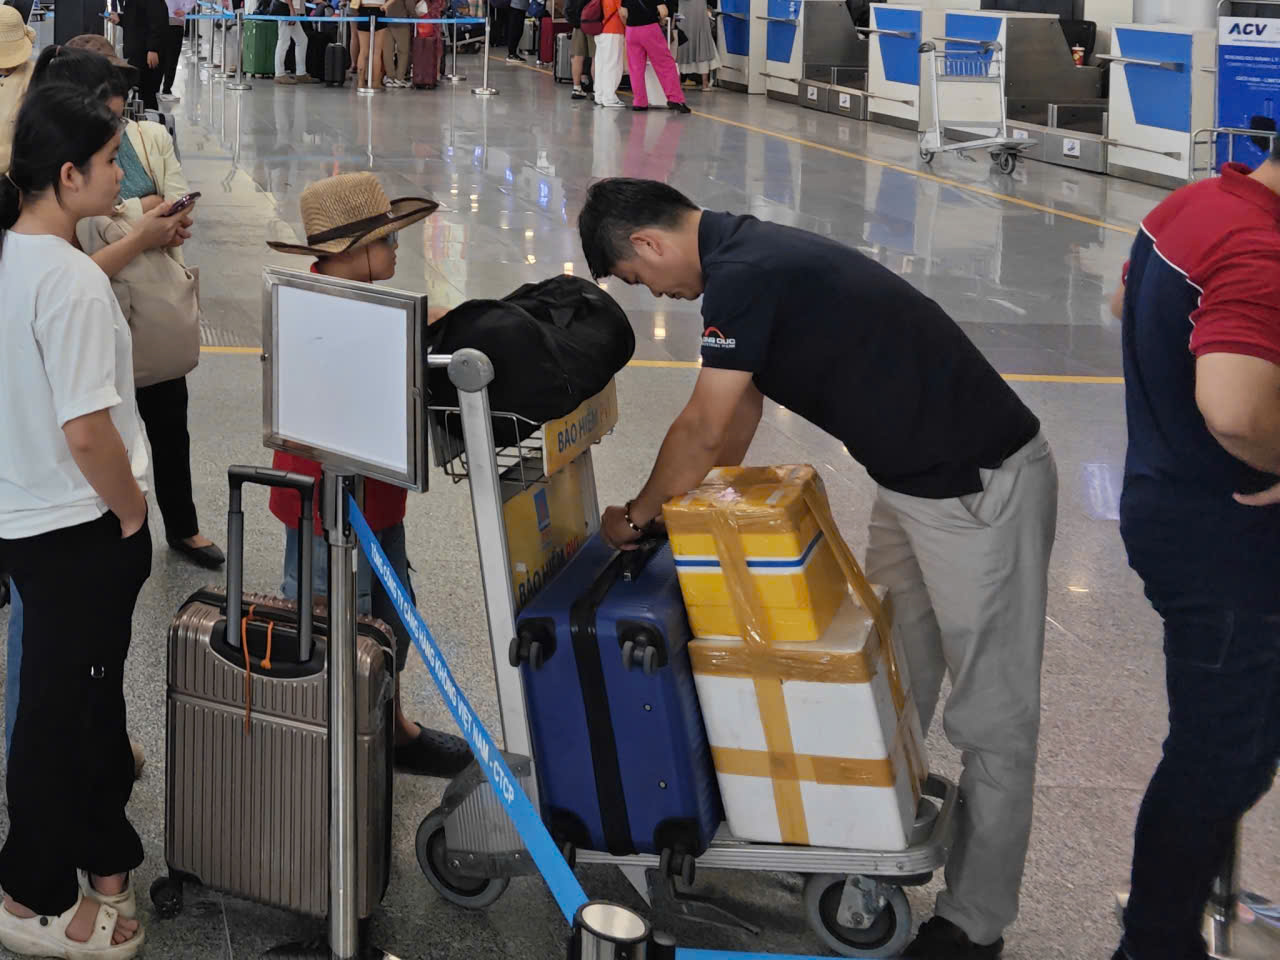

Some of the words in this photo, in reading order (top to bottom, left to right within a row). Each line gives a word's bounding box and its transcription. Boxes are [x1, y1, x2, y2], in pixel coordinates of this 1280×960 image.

[1228, 23, 1268, 36] ACV
[557, 421, 578, 453] BẢO
[383, 565, 397, 600] CÔNG
[396, 587, 404, 610] TY
[418, 628, 436, 668] HÀNG
[434, 656, 457, 706] KHÔNG
[457, 695, 472, 733] VIỆT
[472, 723, 489, 764] NAM
[493, 759, 514, 804] CTCP
